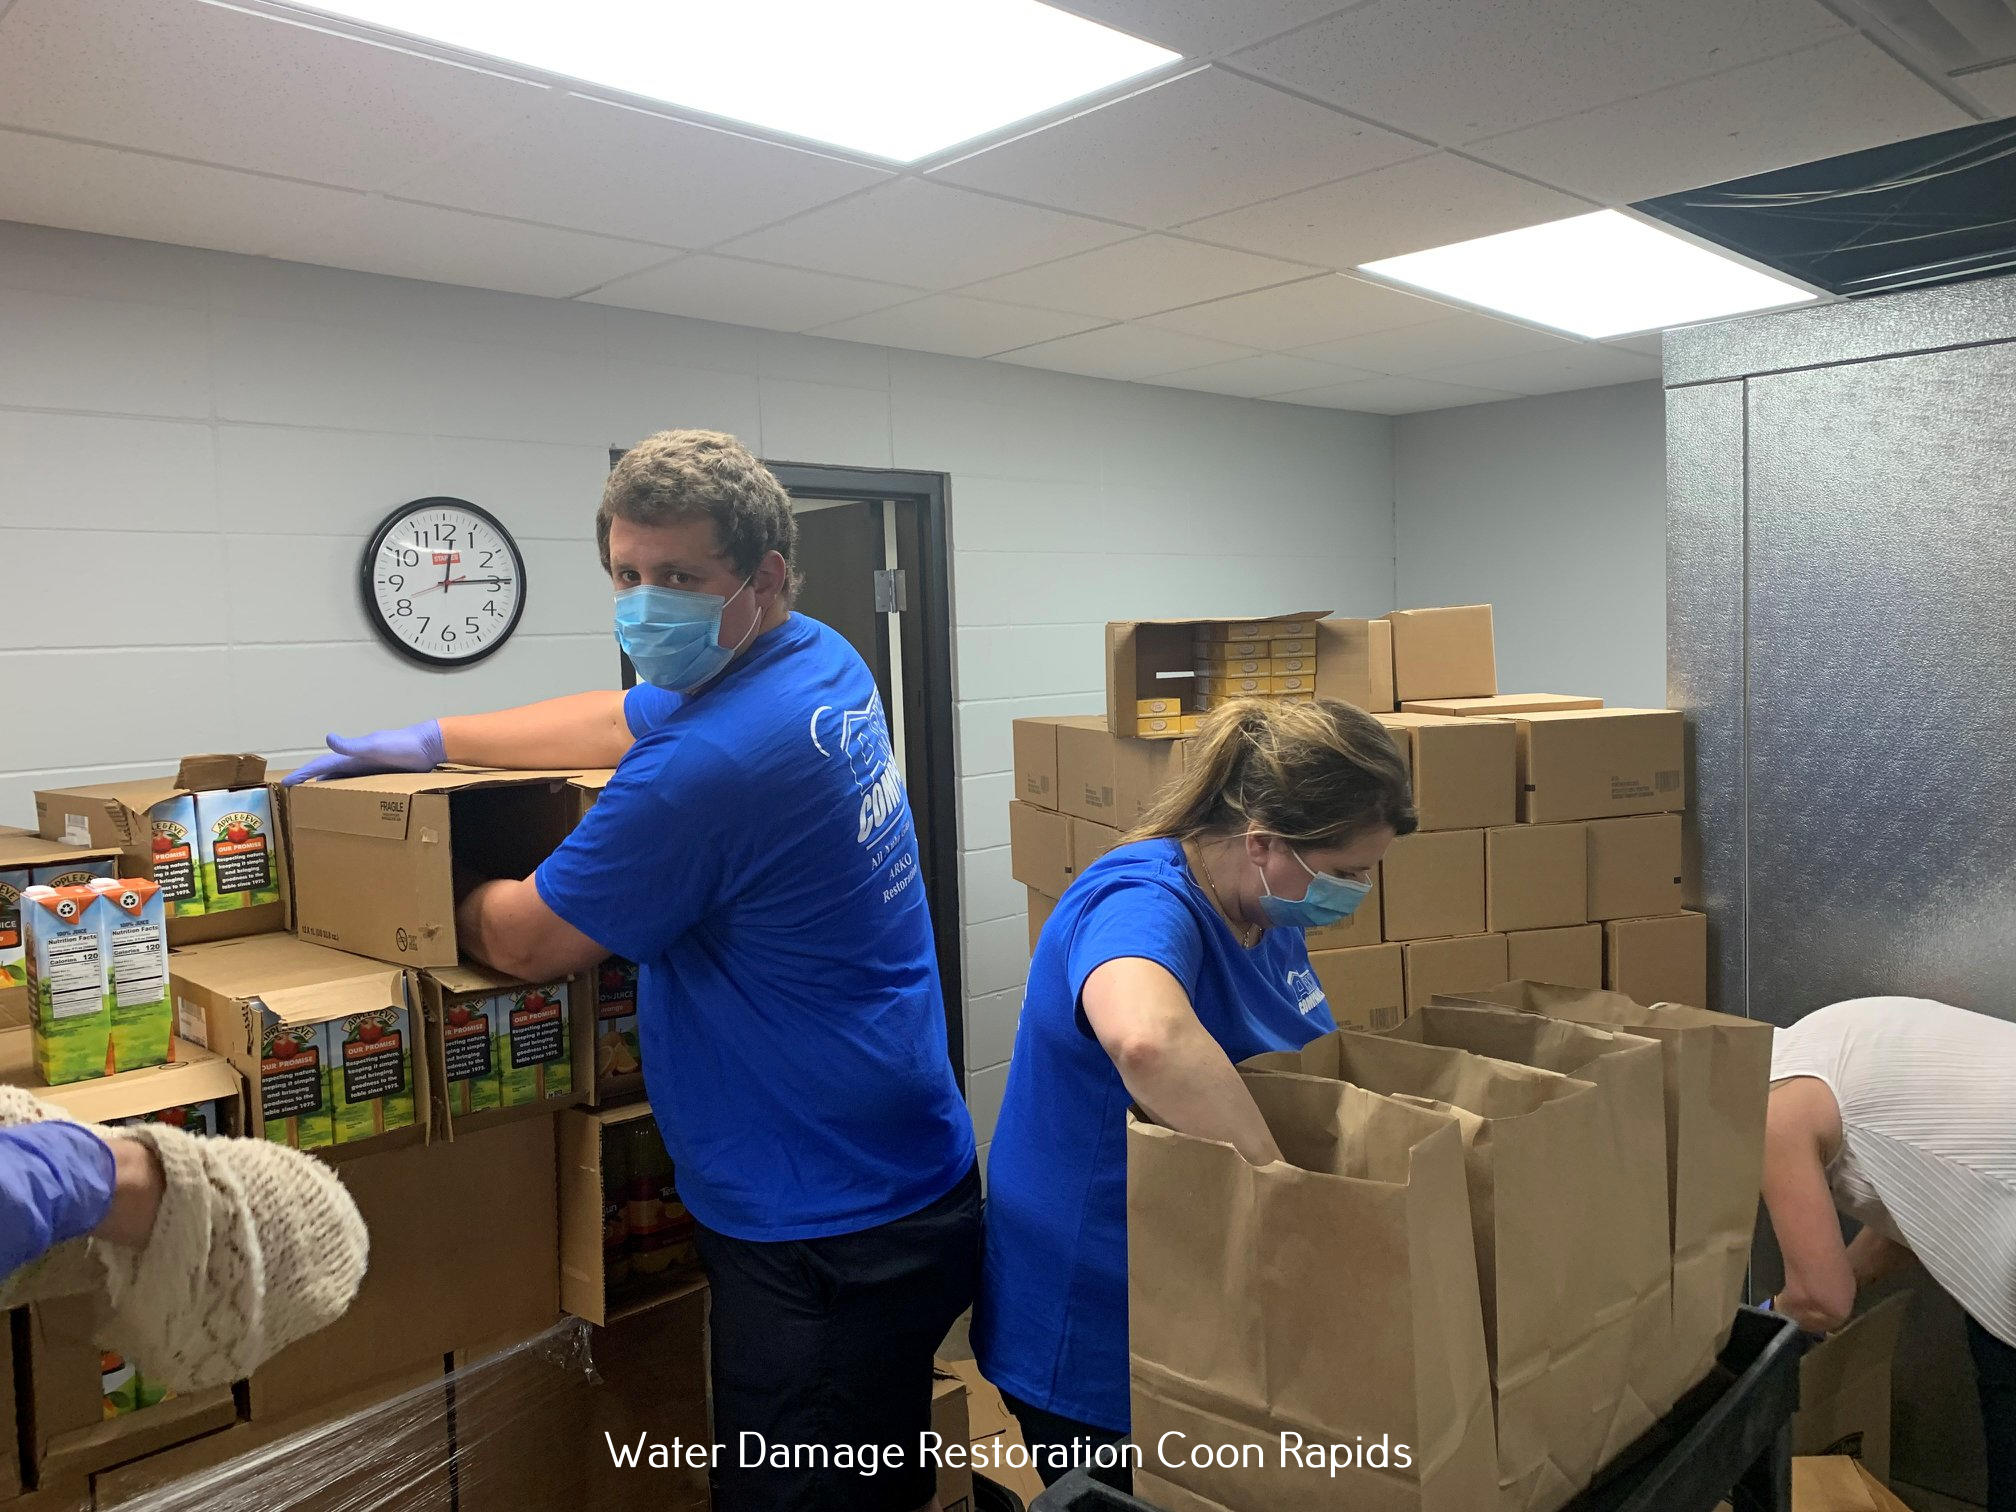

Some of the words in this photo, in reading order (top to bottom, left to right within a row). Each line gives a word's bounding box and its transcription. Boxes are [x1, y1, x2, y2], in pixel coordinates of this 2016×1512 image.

[414, 530, 429, 548] 11
[434, 523, 457, 542] 12
[467, 532, 474, 549] 1
[394, 549, 419, 567] 10
[479, 551, 494, 568] 2
[389, 574, 404, 592] 9
[486, 575, 501, 592] 3
[396, 599, 413, 617] 8
[482, 600, 497, 617] 4
[416, 616, 431, 634] 7
[465, 616, 480, 634] 5
[441, 624, 457, 642] 6
[234, 841, 262, 851] PROMISE
[155, 850, 187, 860] PROMISE
[0, 920, 17, 929] ICE
[112, 928, 140, 936] Nutrition
[48, 937, 77, 945] Nutrition
[83, 952, 99, 960] 120
[113, 948, 140, 956] Calories
[146, 943, 160, 951] 120
[514, 1015, 528, 1023] OUR
[529, 1009, 557, 1020] PROMISE
[453, 1023, 483, 1035] PROMISE
[348, 1046, 364, 1055] OUR
[365, 1040, 396, 1051] PROMISE
[279, 1056, 313, 1068] PROMISE
[262, 1072, 294, 1083] especting
[264, 1108, 280, 1116] able
